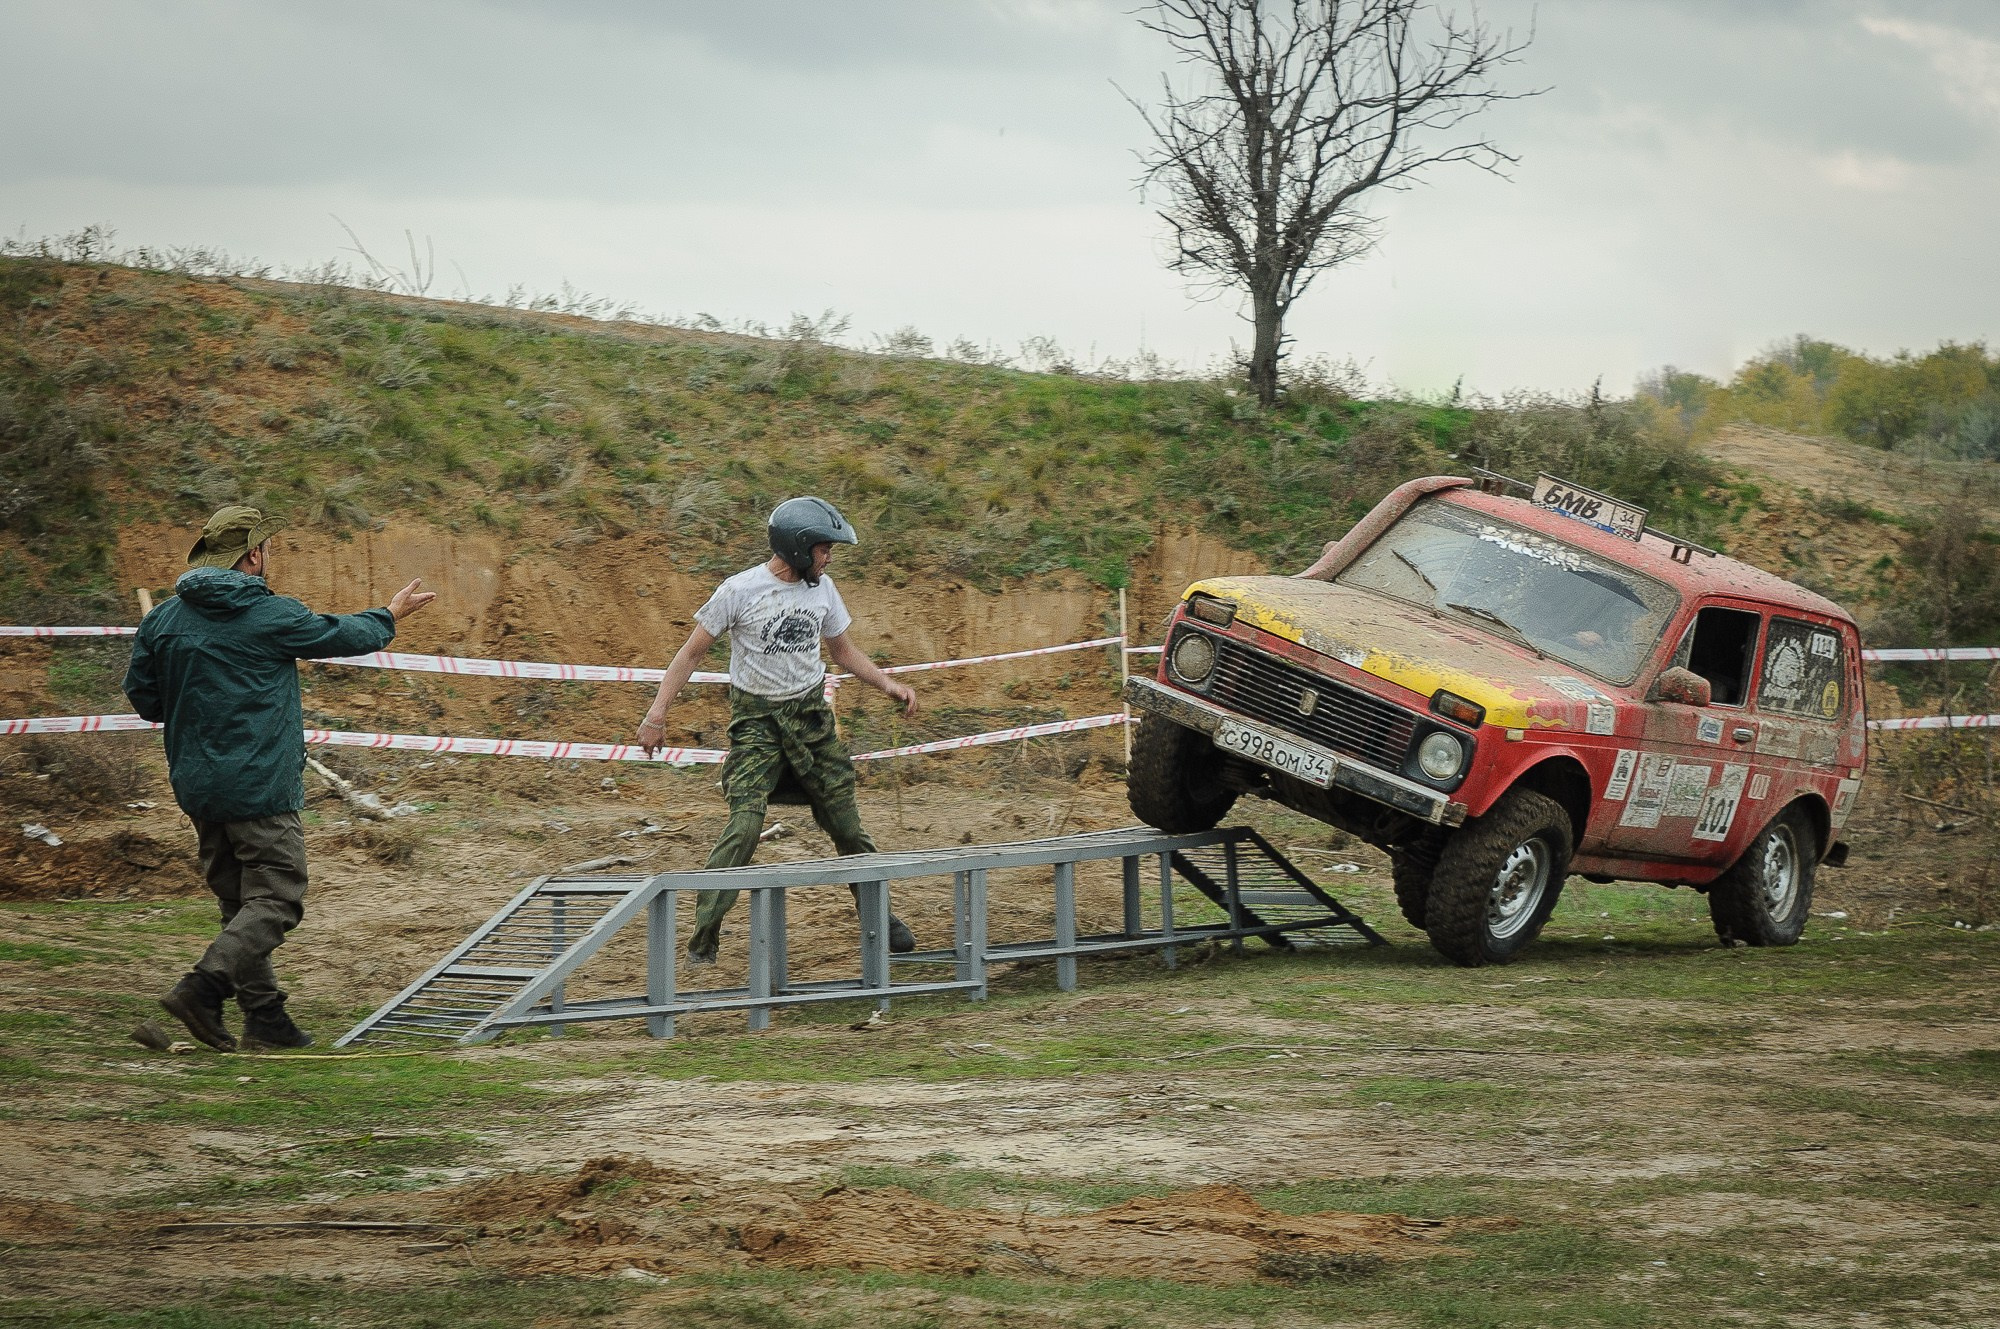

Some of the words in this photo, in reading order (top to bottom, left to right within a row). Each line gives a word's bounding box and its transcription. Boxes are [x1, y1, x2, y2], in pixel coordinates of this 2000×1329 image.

[1620, 510, 1635, 525] 34
[1304, 754, 1325, 775] 34
[1697, 796, 1734, 835] 101
